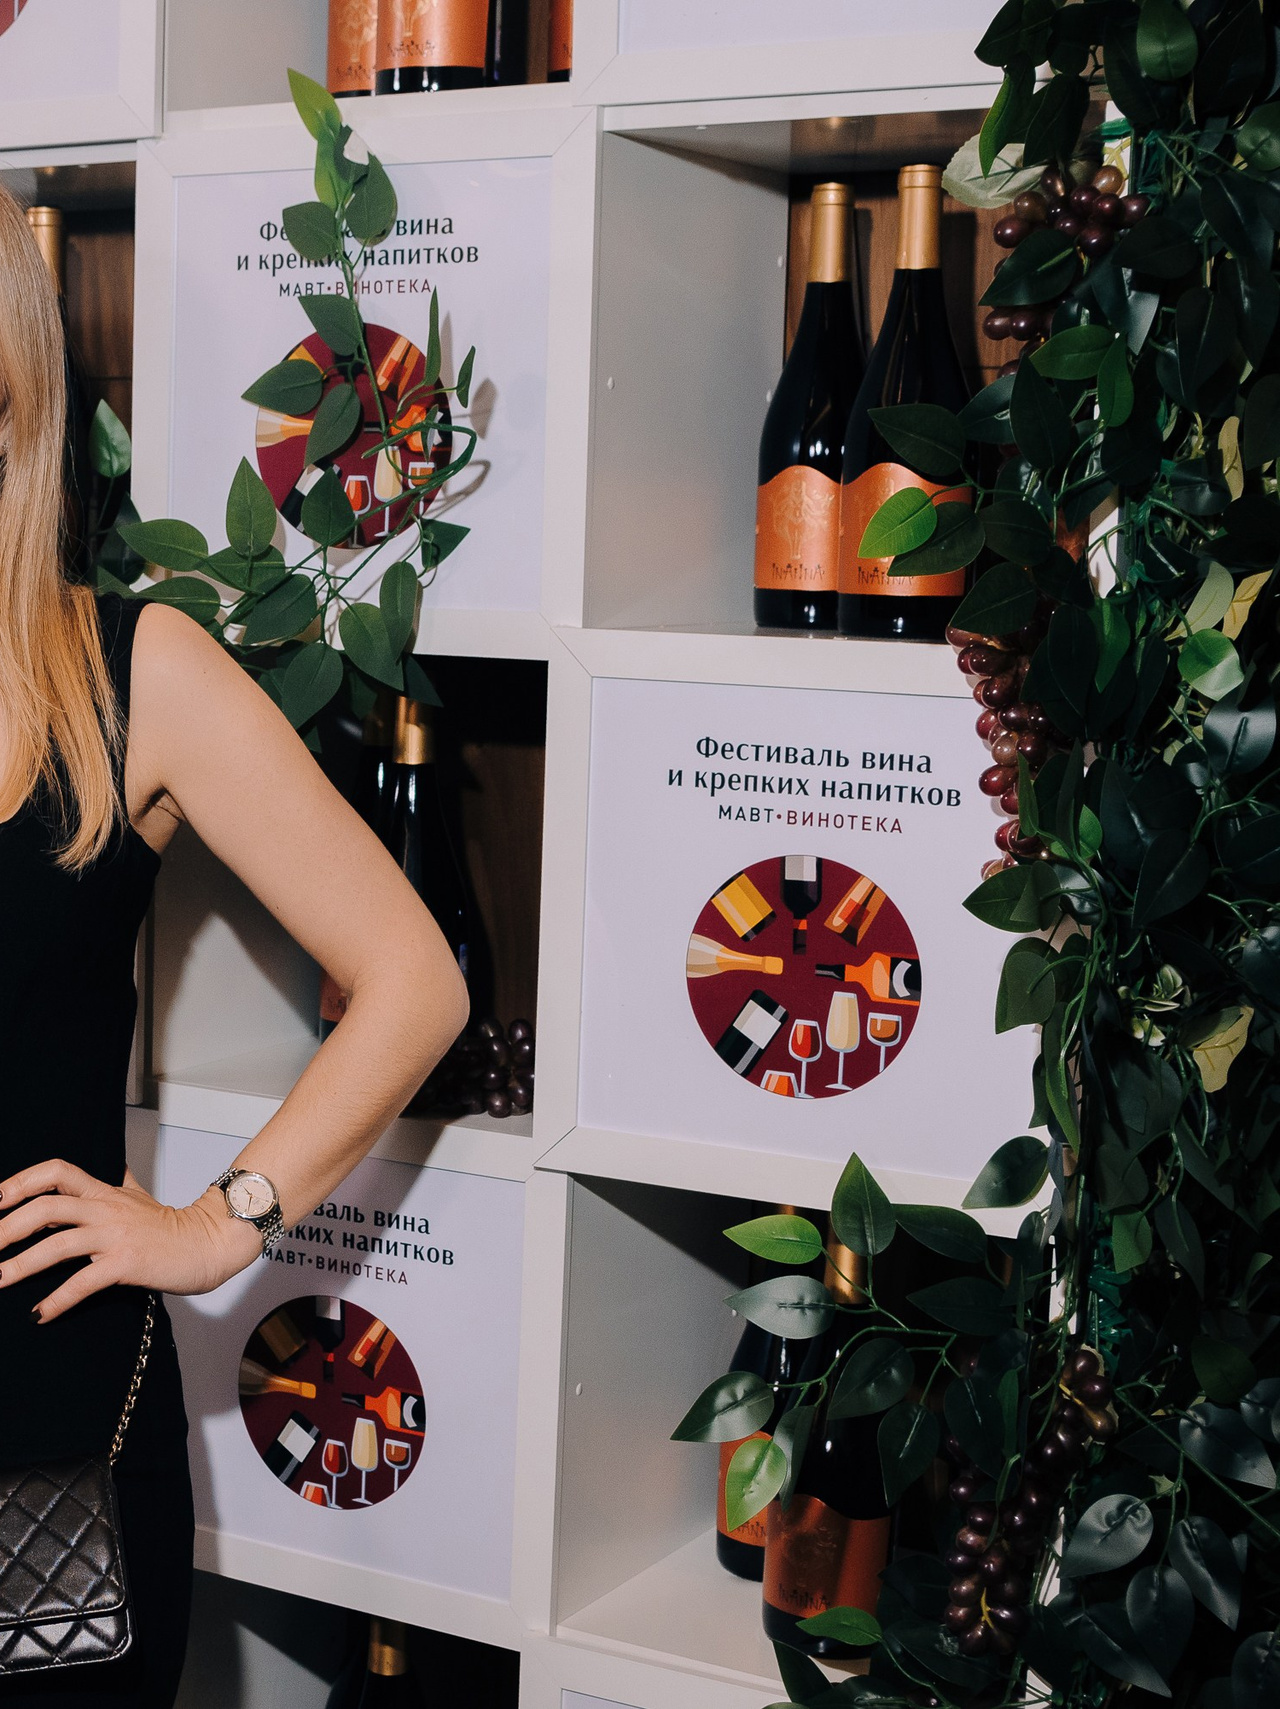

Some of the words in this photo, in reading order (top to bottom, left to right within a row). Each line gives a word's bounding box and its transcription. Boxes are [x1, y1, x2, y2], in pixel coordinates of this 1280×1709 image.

[396, 217, 454, 236] вина
[237, 254, 250, 271] и
[363, 246, 480, 267] напитков
[696, 736, 850, 768] Фестиваль
[861, 752, 933, 774] вина
[668, 768, 683, 786] и
[694, 770, 810, 798] крепких
[821, 780, 962, 807] напитков
[373, 1209, 431, 1235] вина
[342, 1232, 455, 1266] напитков
